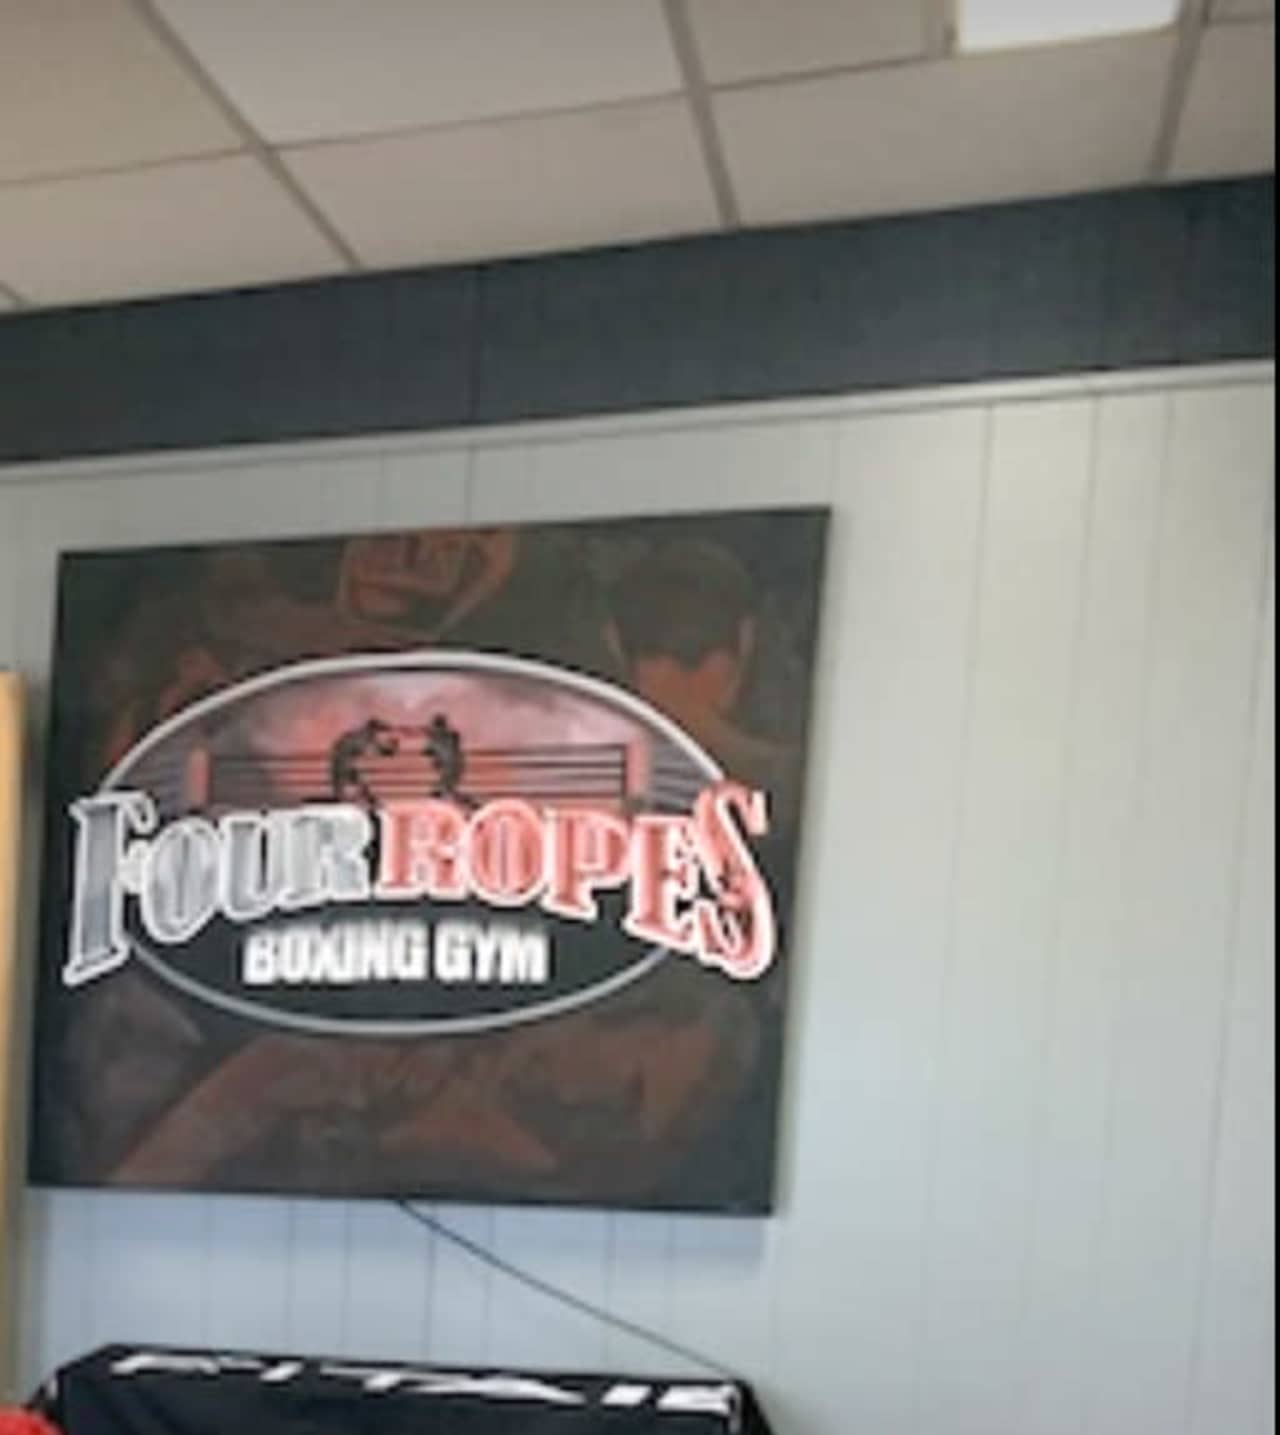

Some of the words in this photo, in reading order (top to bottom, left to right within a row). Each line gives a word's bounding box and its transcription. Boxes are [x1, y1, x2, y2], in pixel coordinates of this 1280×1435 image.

[63, 789, 374, 985] FOUR
[375, 782, 776, 980] ROPES
[243, 920, 429, 987] BOXING
[435, 918, 549, 986] GYM
